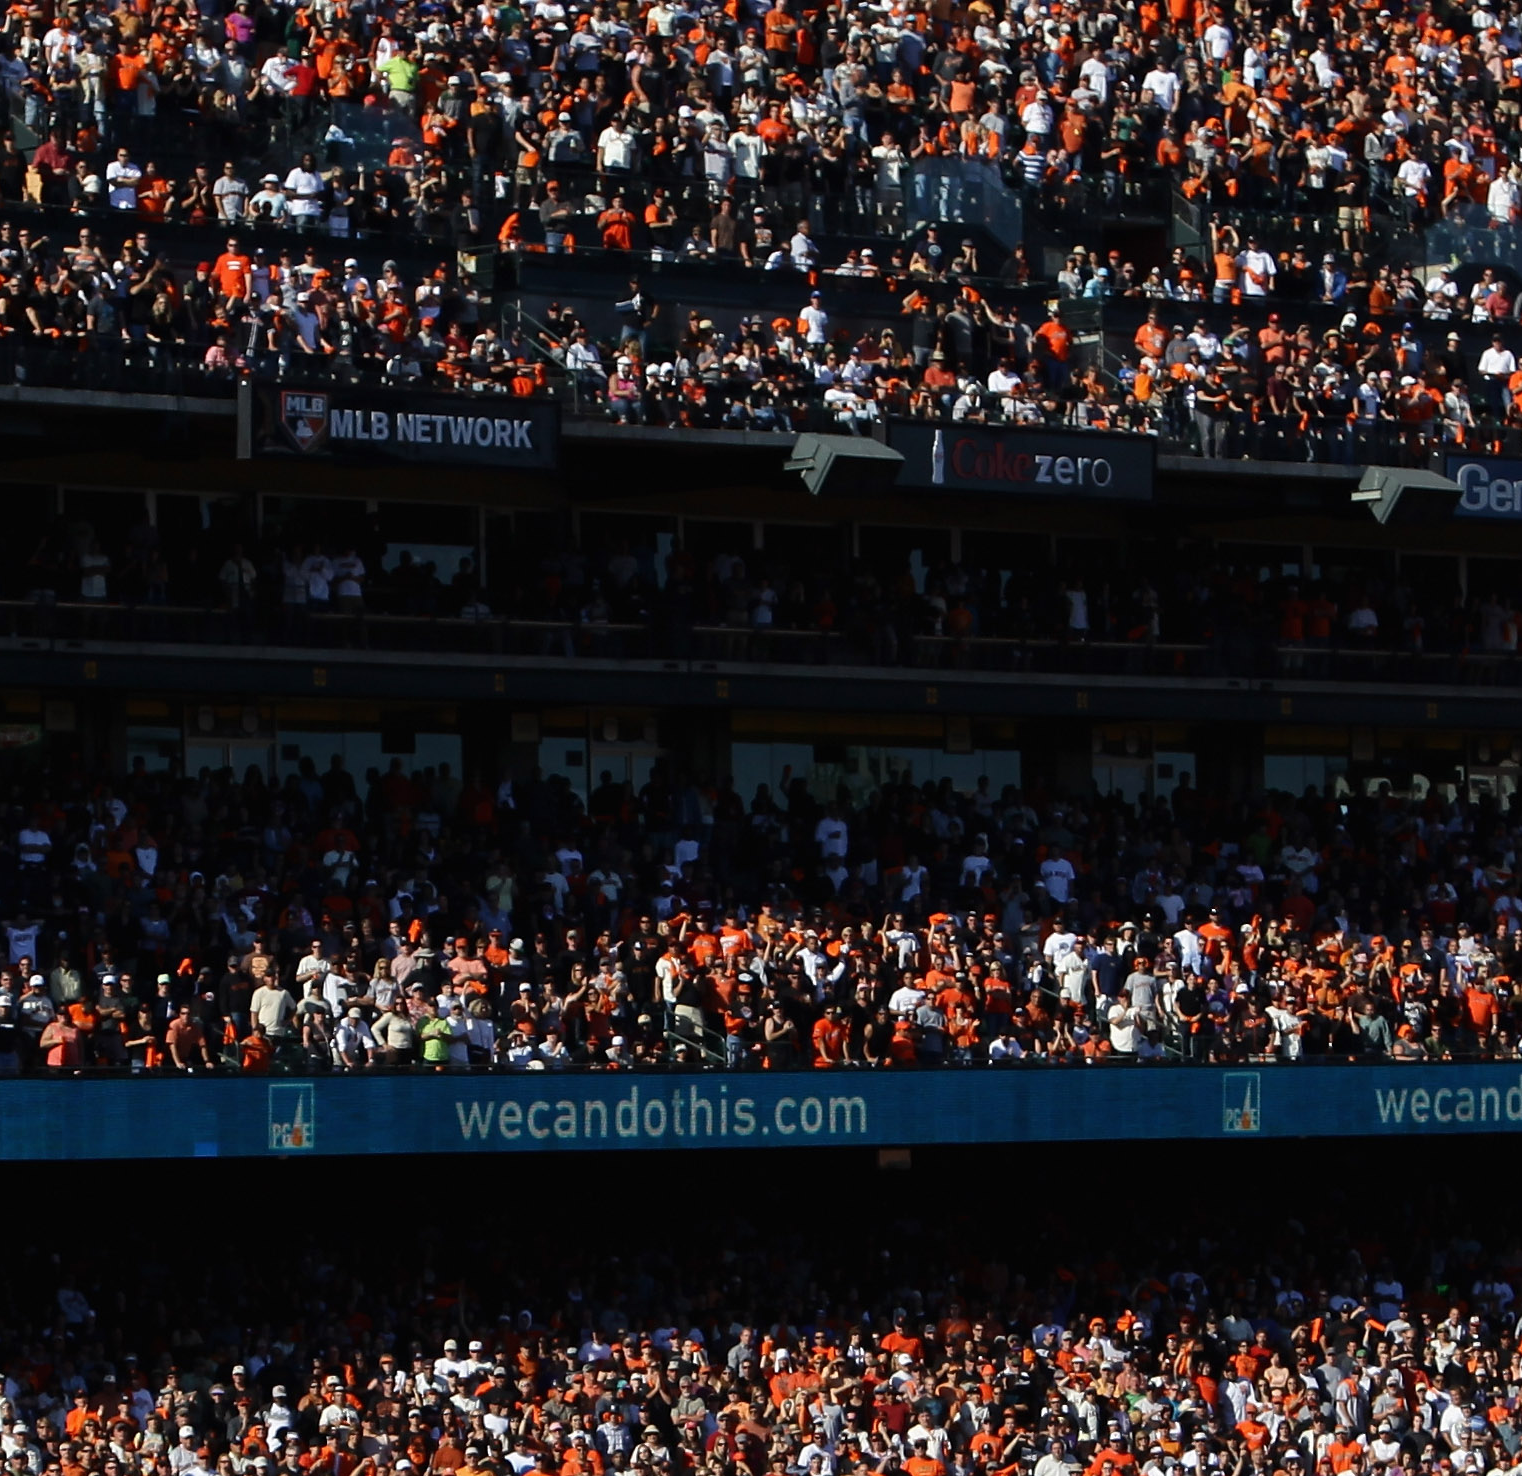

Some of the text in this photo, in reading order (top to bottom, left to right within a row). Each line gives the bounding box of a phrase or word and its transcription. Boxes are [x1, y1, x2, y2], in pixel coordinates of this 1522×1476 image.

[286, 395, 325, 413] MLB
[330, 408, 534, 449] MLB NETWORK
[951, 437, 1114, 488] Coke zero
[457, 1086, 868, 1139] wecandothis.com
